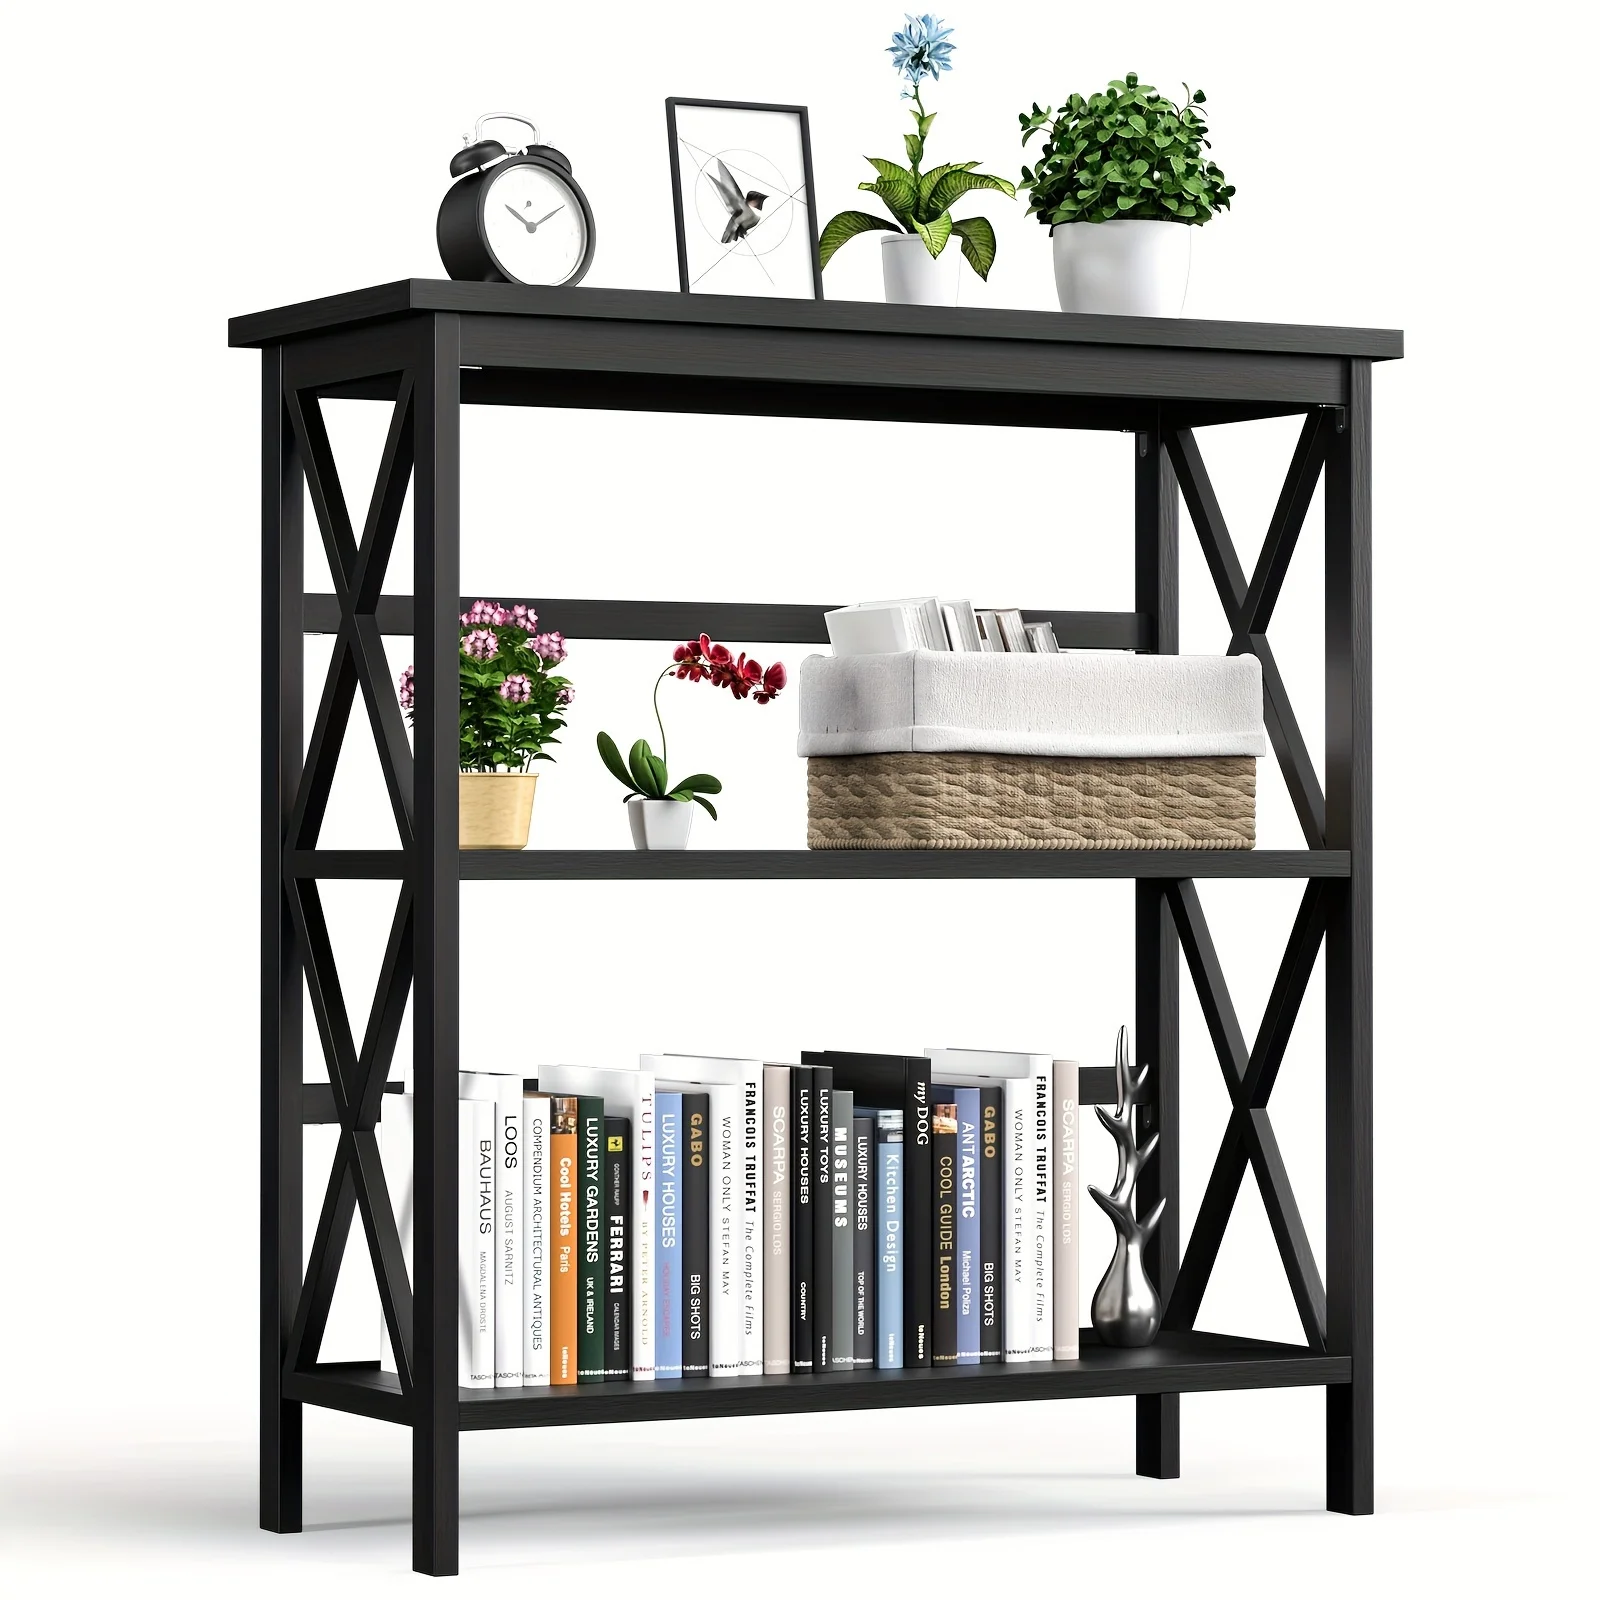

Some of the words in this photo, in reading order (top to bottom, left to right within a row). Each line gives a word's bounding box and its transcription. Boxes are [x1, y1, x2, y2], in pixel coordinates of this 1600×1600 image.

[745, 1082, 756, 1149] FRANCOIS
[800, 1089, 809, 1142] LUXURY
[820, 1089, 828, 1142] LUXURY
[914, 1082, 927, 1103] my
[1036, 1076, 1046, 1140] FRANCOIS
[505, 1115, 518, 1169] LOOS
[586, 1117, 598, 1180] LUXURY
[642, 1093, 652, 1180] TULIPS
[662, 1113, 675, 1177] LUXURY
[691, 1113, 702, 1167] GABO
[722, 1117, 731, 1171] WOMAN
[773, 1106, 785, 1184] SCARPA
[917, 1107, 928, 1145] DOG
[984, 1106, 995, 1158] GABO
[1014, 1109, 1023, 1161] WOMAN
[1063, 1099, 1074, 1174] SCARPA
[532, 1118, 542, 1195] COMPENDIUM
[560, 1157, 572, 1188] Cool
[800, 1147, 809, 1204] HOUSES
[820, 1147, 828, 1183] TOYS
[835, 1127, 847, 1227] MUSEUMS
[858, 1136, 867, 1180] LUXURY
[940, 1156, 951, 1198] COOL
[963, 1122, 975, 1218] ANTARCTIC
[1036, 1148, 1046, 1203] TRUFFAT
[479, 1140, 492, 1234] BAUHAUS
[722, 1176, 731, 1212] ONLY
[745, 1156, 756, 1212] TRUFFAT
[858, 1183, 867, 1230] HOUSES
[886, 1154, 899, 1213] Kitchen
[1014, 1167, 1023, 1201] ONLY
[1063, 1181, 1071, 1220] SERGIO
[504, 1190, 514, 1235] AUGUST
[560, 1192, 572, 1236] Hotels
[586, 1185, 598, 1262] GARDENS
[642, 1222, 648, 1236] BY
[662, 1182, 675, 1248] HOUSES
[745, 1221, 754, 1241] The
[773, 1191, 782, 1230] SERGIO
[940, 1204, 951, 1250] GUIDE
[1036, 1211, 1045, 1231] The
[1063, 1223, 1071, 1244] LOS
[504, 1239, 514, 1285] SARNITZ
[532, 1199, 542, 1290] ARCHITECTURAL
[560, 1246, 570, 1273] Paris
[610, 1215, 623, 1293] FERRARI
[773, 1234, 782, 1255] LOS
[883, 1221, 899, 1272] Design
[962, 1250, 972, 1284] Michael
[1035, 1235, 1045, 1288] Complete
[479, 1252, 487, 1300] MAGDALENA
[587, 1277, 594, 1289] UK
[691, 1274, 700, 1294] BIG
[744, 1246, 754, 1301] Complete
[858, 1287, 864, 1296] OF
[940, 1256, 952, 1309] London
[984, 1262, 994, 1282] BIG
[479, 1302, 487, 1333] DROSTE
[532, 1293, 542, 1350] ANTIQUES
[690, 1298, 700, 1339] SHOTS
[745, 1306, 754, 1335] Films
[962, 1288, 972, 1315] Poliza
[984, 1286, 994, 1325] SHOTS
[1036, 1293, 1045, 1322] Films
